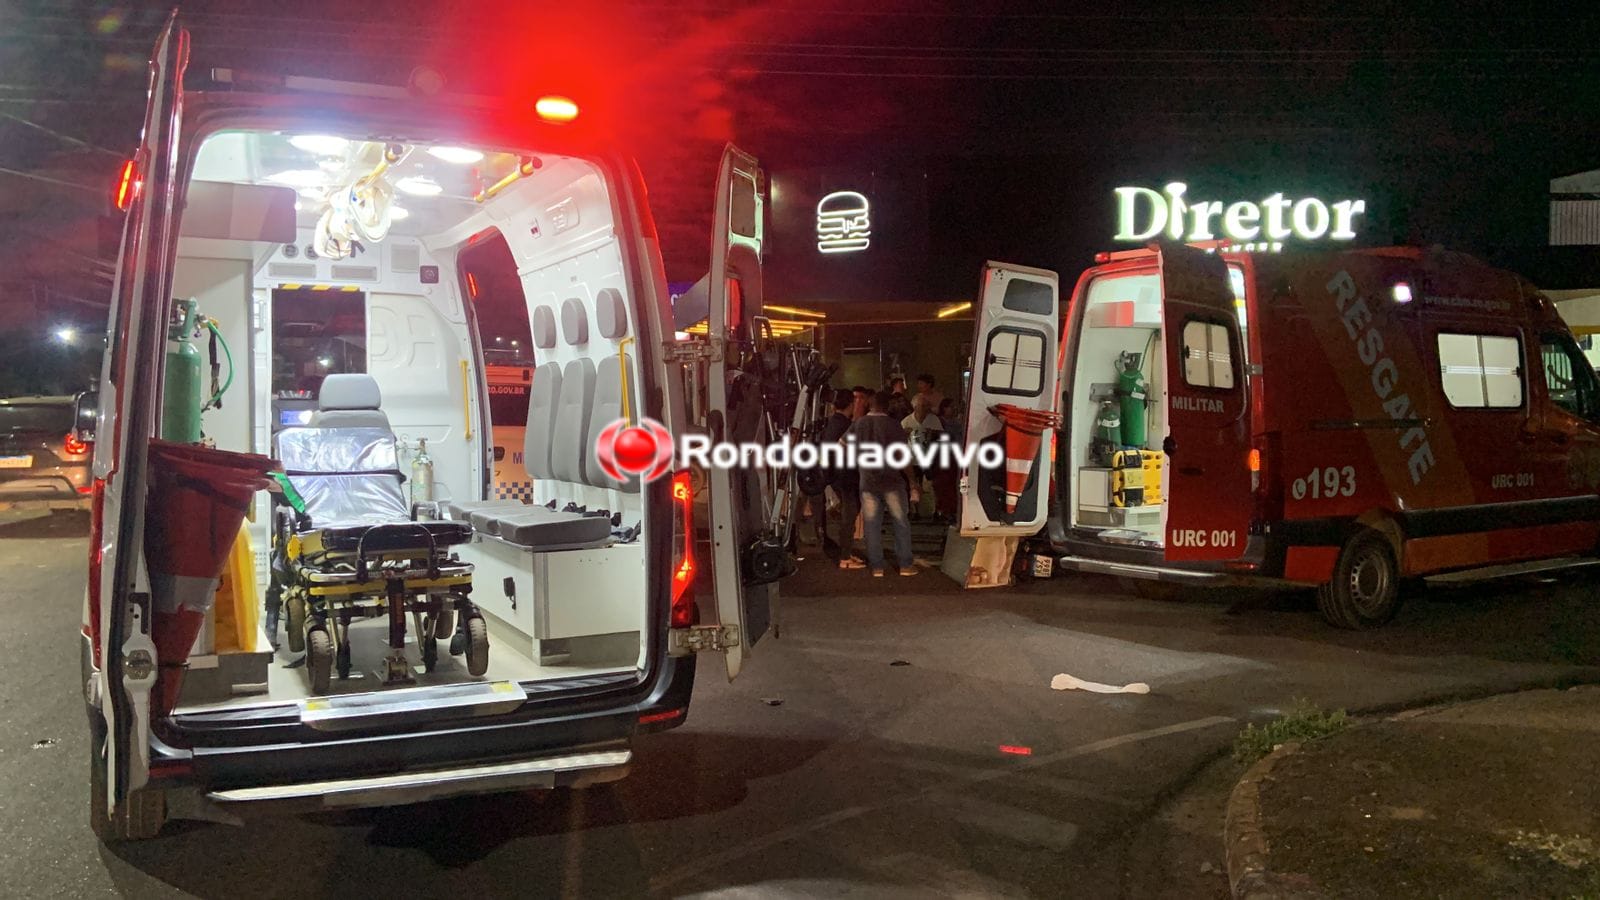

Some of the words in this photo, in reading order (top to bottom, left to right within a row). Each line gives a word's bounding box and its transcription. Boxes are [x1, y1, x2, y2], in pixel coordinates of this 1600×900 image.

[1113, 181, 1366, 241] Diretor
[1326, 269, 1436, 485] RESGATE
[1172, 396, 1224, 413] MILITAR
[1307, 466, 1356, 499] 193
[1491, 474, 1514, 489] URC
[1516, 472, 1534, 487] 001
[1172, 529, 1207, 547] URC
[1211, 530, 1236, 547] 001
